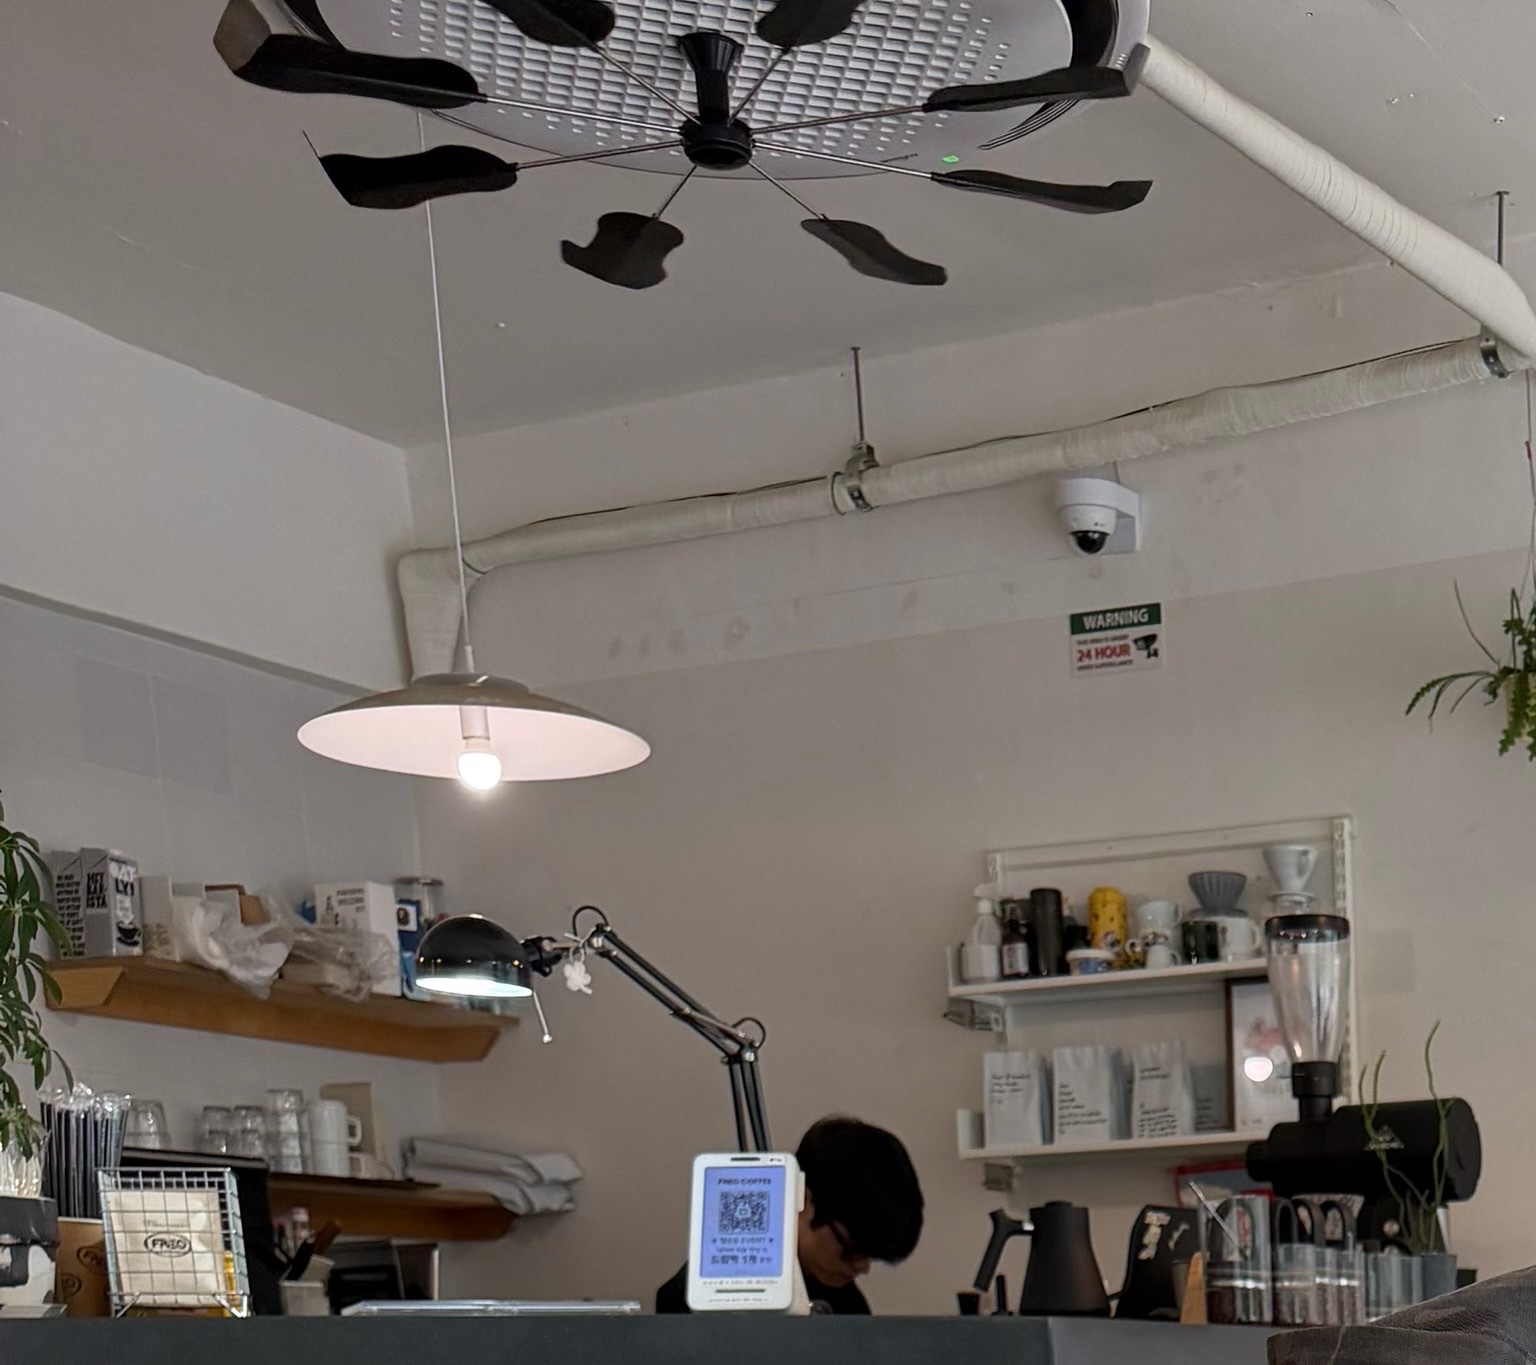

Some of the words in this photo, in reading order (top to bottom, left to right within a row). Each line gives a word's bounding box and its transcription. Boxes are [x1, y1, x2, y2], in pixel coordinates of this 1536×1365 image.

[1083, 608, 1149, 630] WARNING
[1077, 648, 1092, 662] 24
[1095, 643, 1131, 660] HOUR
